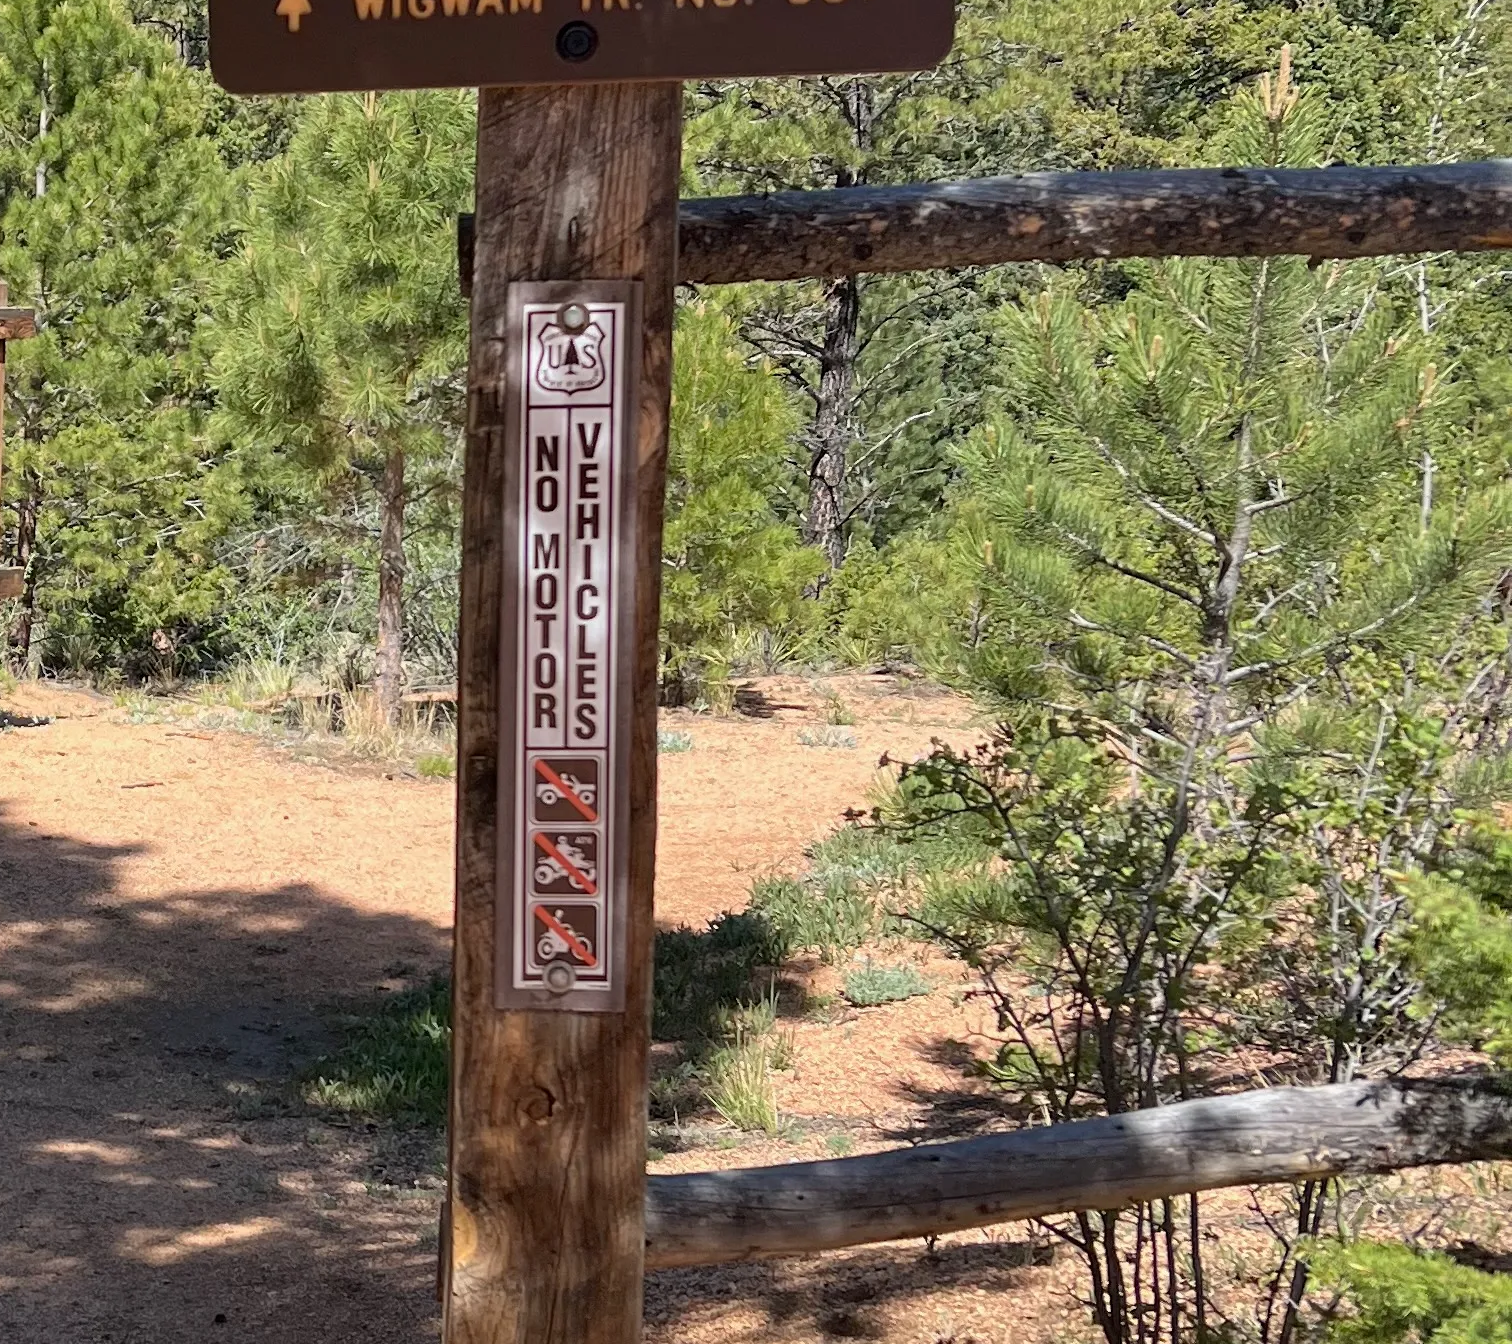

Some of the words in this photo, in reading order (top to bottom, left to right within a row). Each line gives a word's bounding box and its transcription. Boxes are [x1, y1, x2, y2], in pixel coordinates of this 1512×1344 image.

[535, 435, 560, 513] NO
[533, 533, 560, 729] MOTOR
[574, 422, 603, 740] VEHICLES
